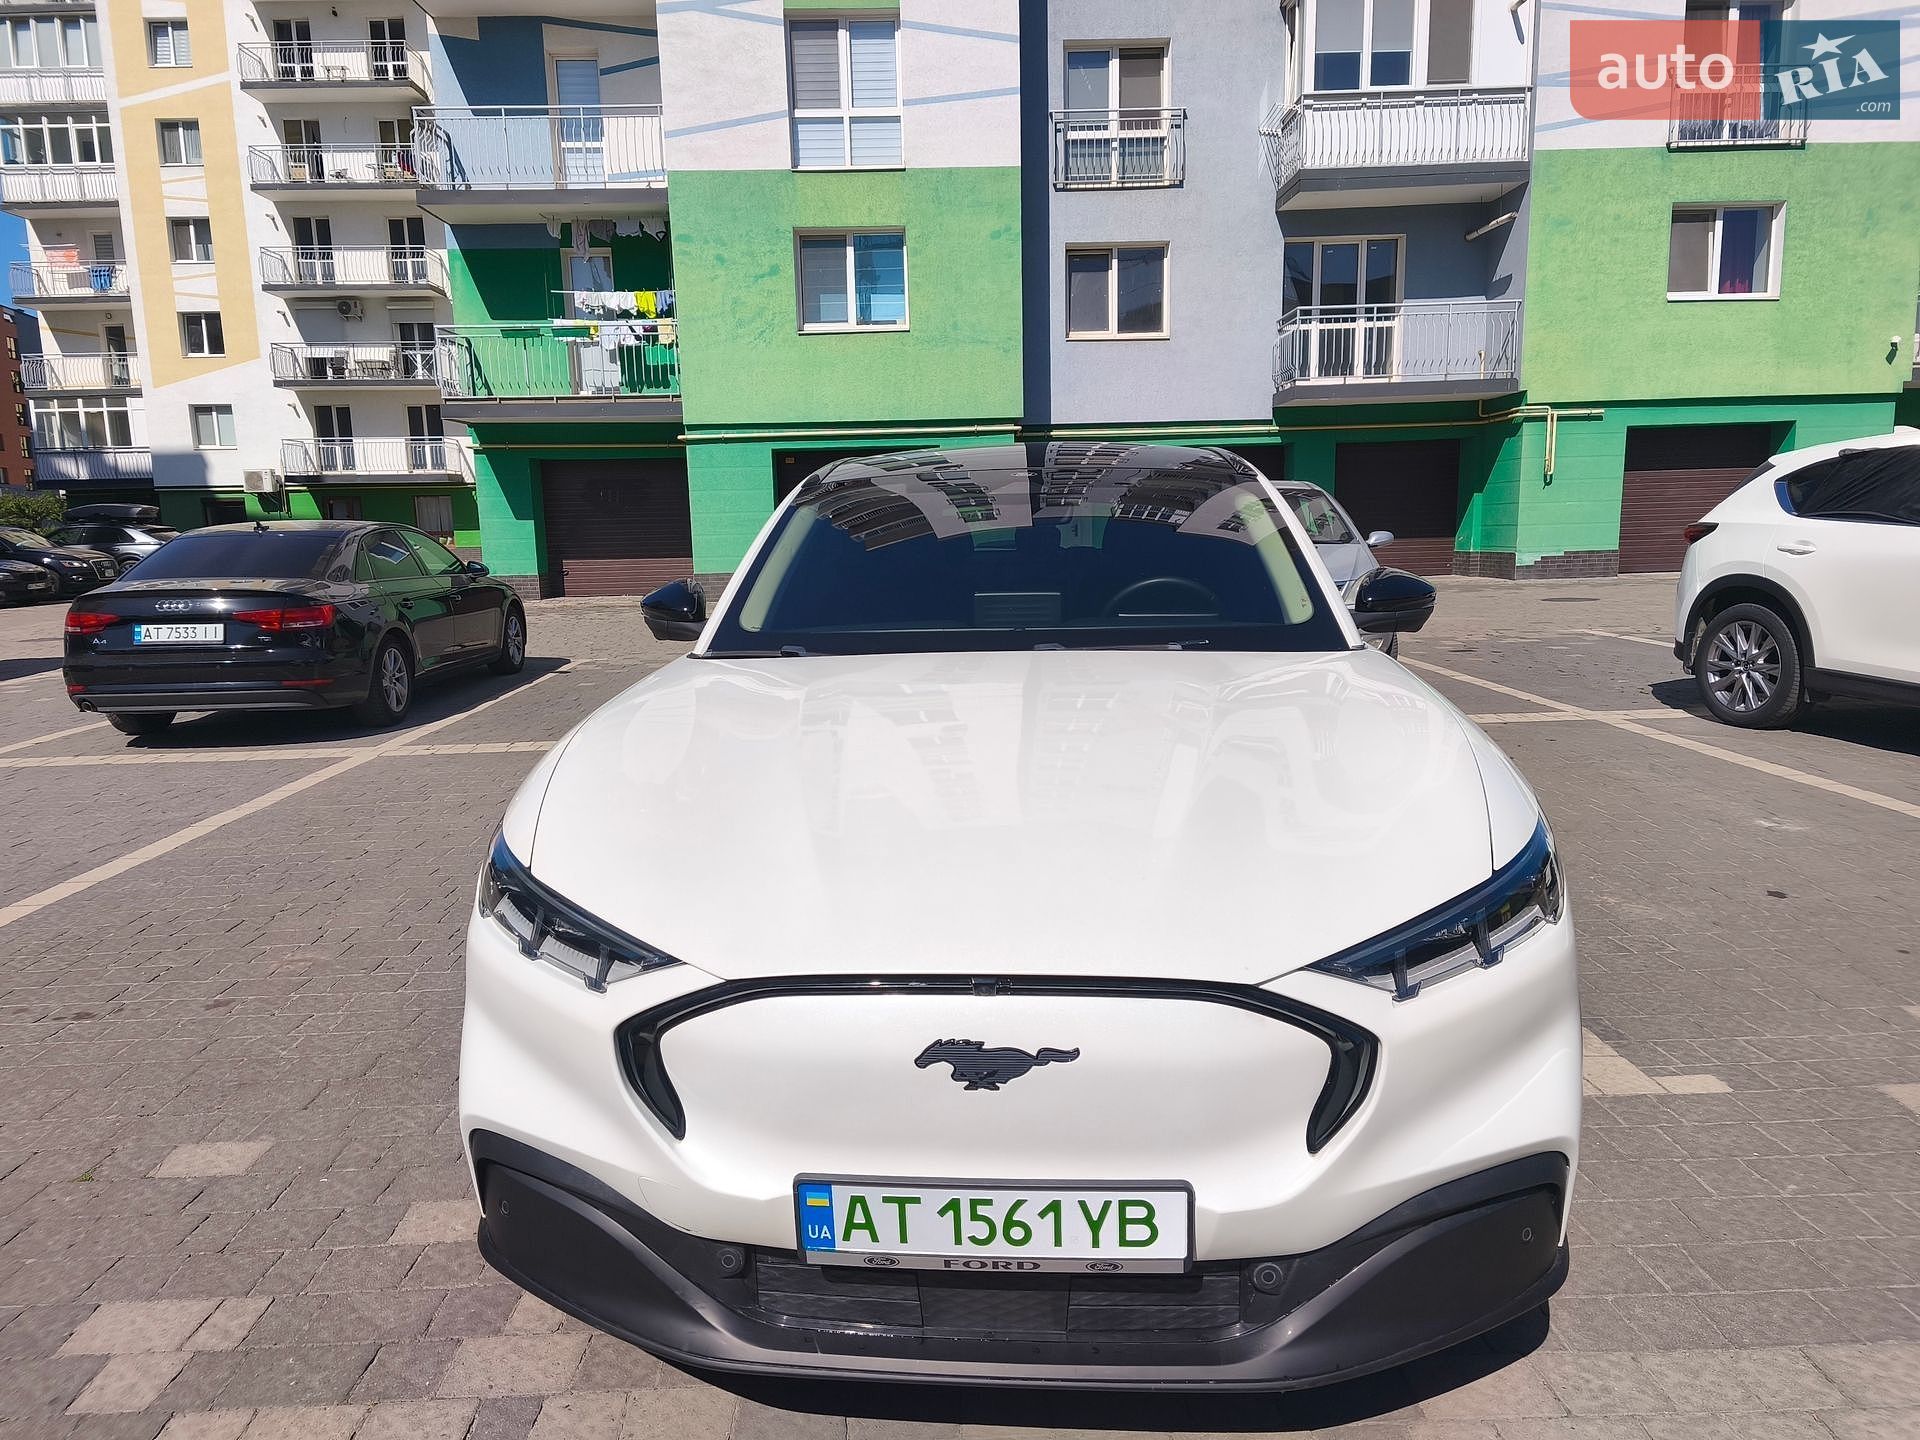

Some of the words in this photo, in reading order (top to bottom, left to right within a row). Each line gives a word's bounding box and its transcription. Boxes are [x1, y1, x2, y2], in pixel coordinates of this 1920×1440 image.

[143, 626, 162, 640] AT
[166, 626, 197, 639] 7533
[842, 1195, 921, 1244] AT
[936, 1198, 1063, 1247] 1561
[1077, 1199, 1159, 1249] YB
[808, 1224, 832, 1240] UA
[943, 1259, 1041, 1271] FORD
